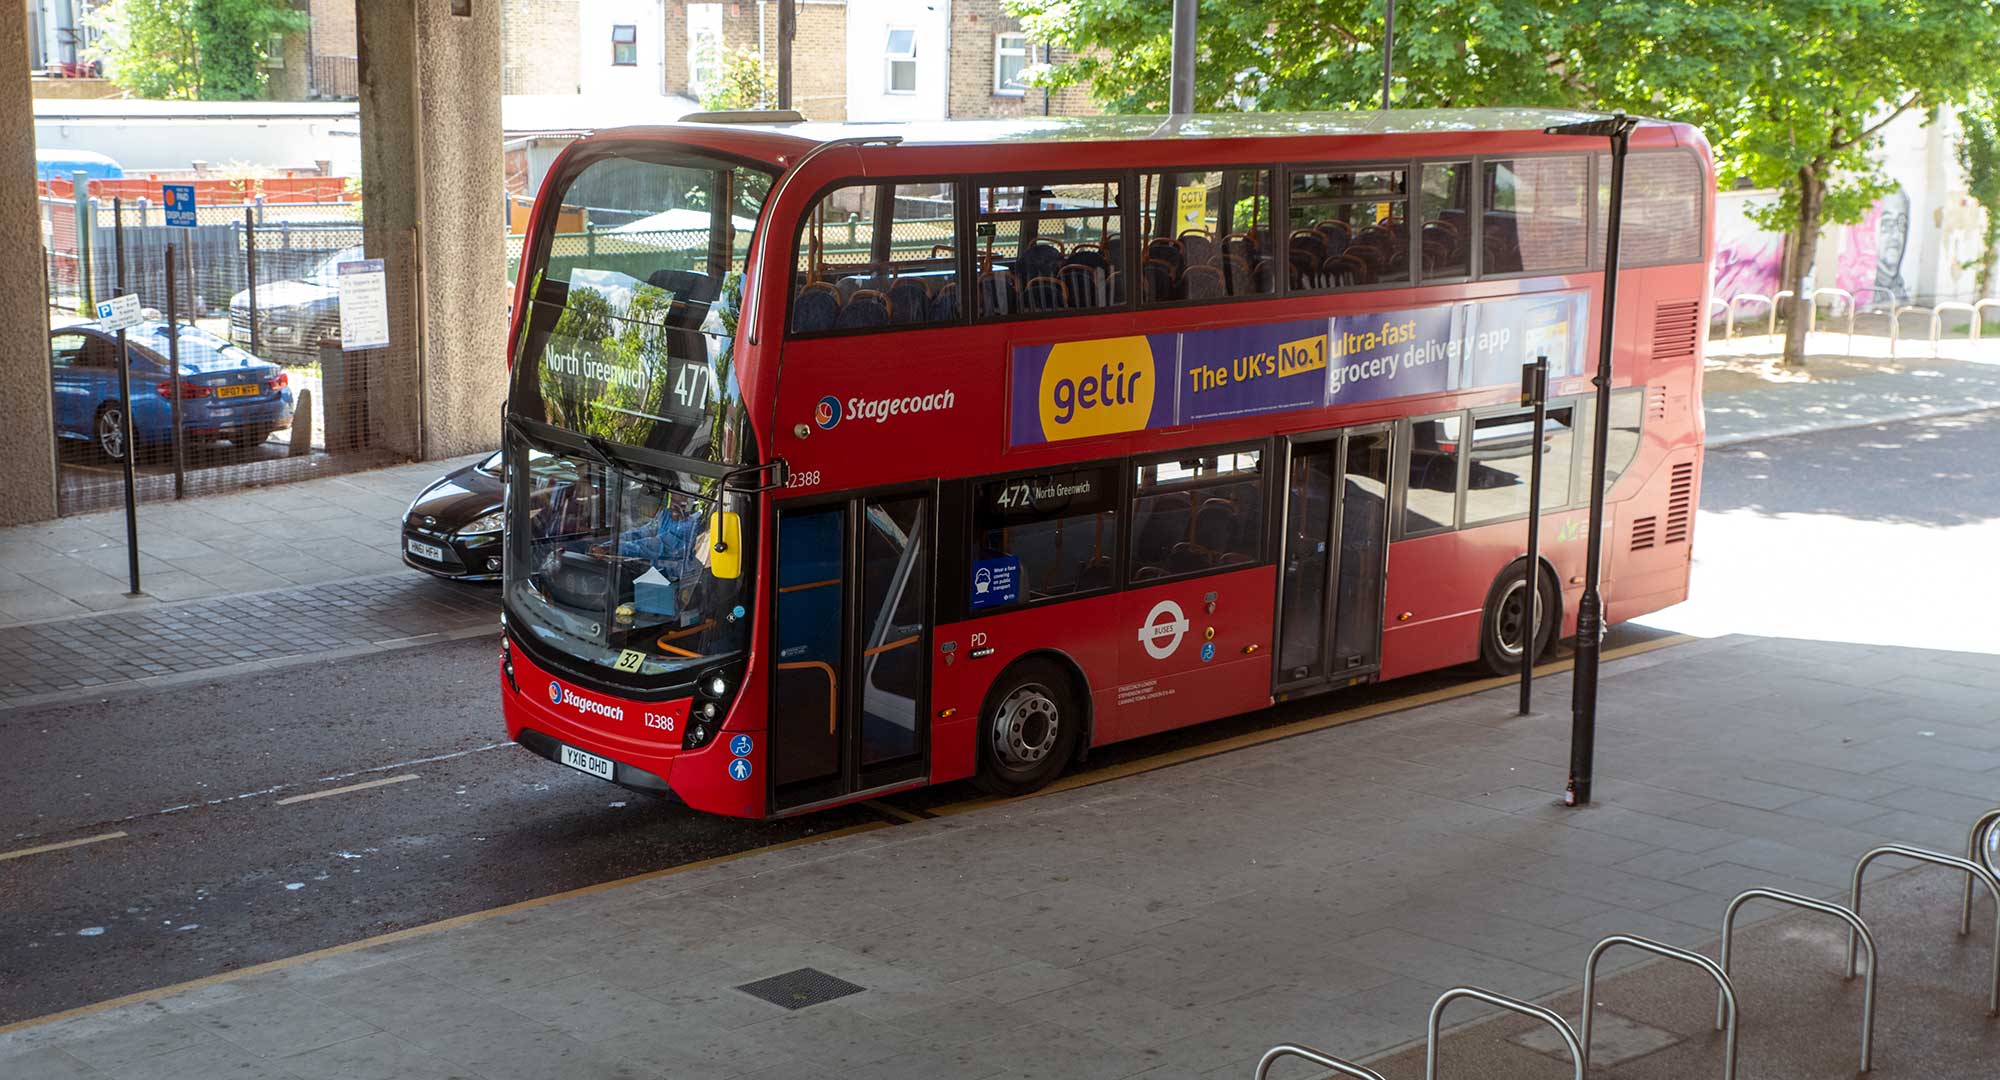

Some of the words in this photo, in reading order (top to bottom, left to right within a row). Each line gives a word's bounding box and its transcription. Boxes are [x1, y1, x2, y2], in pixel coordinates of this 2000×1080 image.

[1181, 191, 1203, 204] CCTV
[1330, 319, 1417, 359] ultra-fast
[545, 343, 579, 376] North
[583, 351, 646, 390] Greenwich
[1189, 364, 1228, 393] The
[1280, 339, 1325, 372] No.1
[1329, 352, 1401, 394] grocery
[1403, 335, 1476, 370] delivery
[1478, 326, 1511, 352] app
[845, 388, 955, 424] Stagecoach
[1053, 361, 1142, 425] getir
[996, 484, 1031, 508] 472
[1035, 485, 1056, 500] North
[1056, 480, 1091, 497] Greenwich
[971, 632, 987, 647] PD
[1154, 624, 1174, 636] BUSES
[619, 652, 640, 669] 32
[563, 688, 624, 721] Stagecoach
[644, 712, 675, 732] 12388
[567, 748, 587, 768] YX16
[588, 758, 608, 775] OHD
